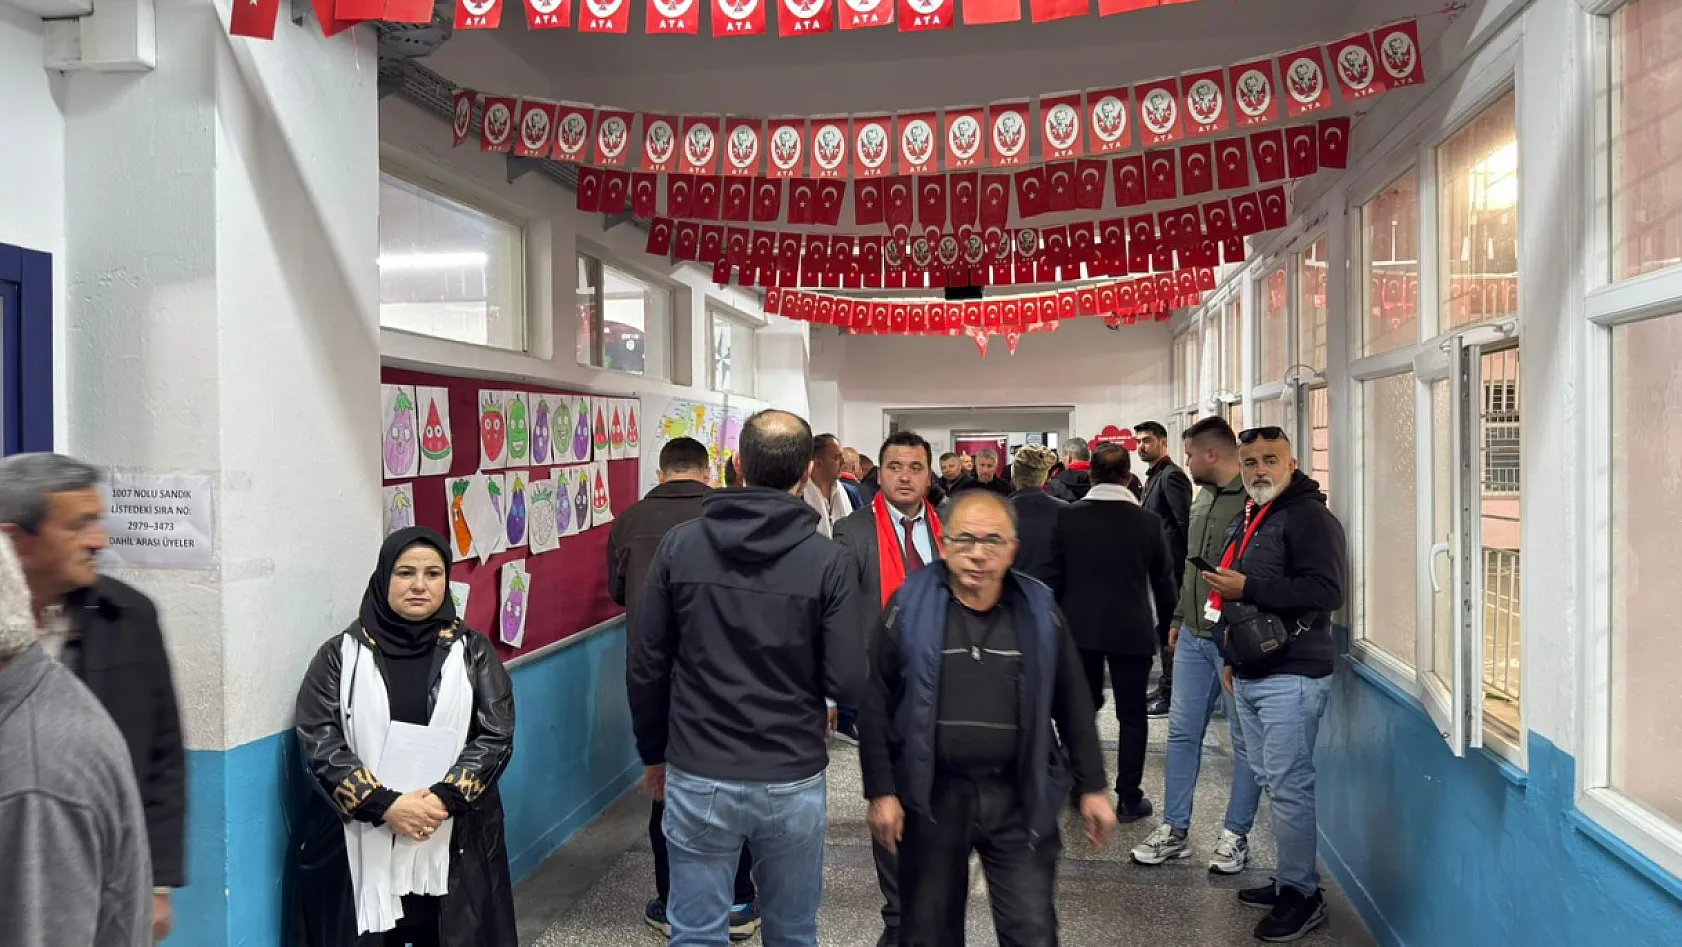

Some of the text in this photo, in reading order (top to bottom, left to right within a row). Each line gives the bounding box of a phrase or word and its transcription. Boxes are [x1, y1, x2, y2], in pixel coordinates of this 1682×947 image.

[465, 17, 486, 26] ATA
[534, 15, 558, 25] ATA
[852, 13, 878, 24] ATA
[913, 15, 941, 26] ATA
[589, 19, 613, 29] ATA
[659, 19, 685, 29] ATA
[726, 21, 752, 31] ATA
[793, 21, 820, 31] ATA
[1394, 77, 1414, 87] ATA
[1354, 87, 1375, 98] ATA
[1300, 101, 1321, 112] ATA
[1247, 115, 1267, 124] ATA
[1198, 123, 1218, 133] ATA
[1153, 134, 1174, 143] ATA
[1101, 142, 1121, 150] ATA
[1053, 149, 1073, 158] ATA
[956, 158, 975, 167] ATA
[1000, 157, 1019, 165] ATA
[909, 165, 928, 173] ATA
[112, 489, 192, 499] 1007 NOLU SANDIK
[111, 504, 192, 515] LİSTEDEKİ SIRA NO:
[109, 535, 195, 548] DAHİL ARASI ÜYELER
